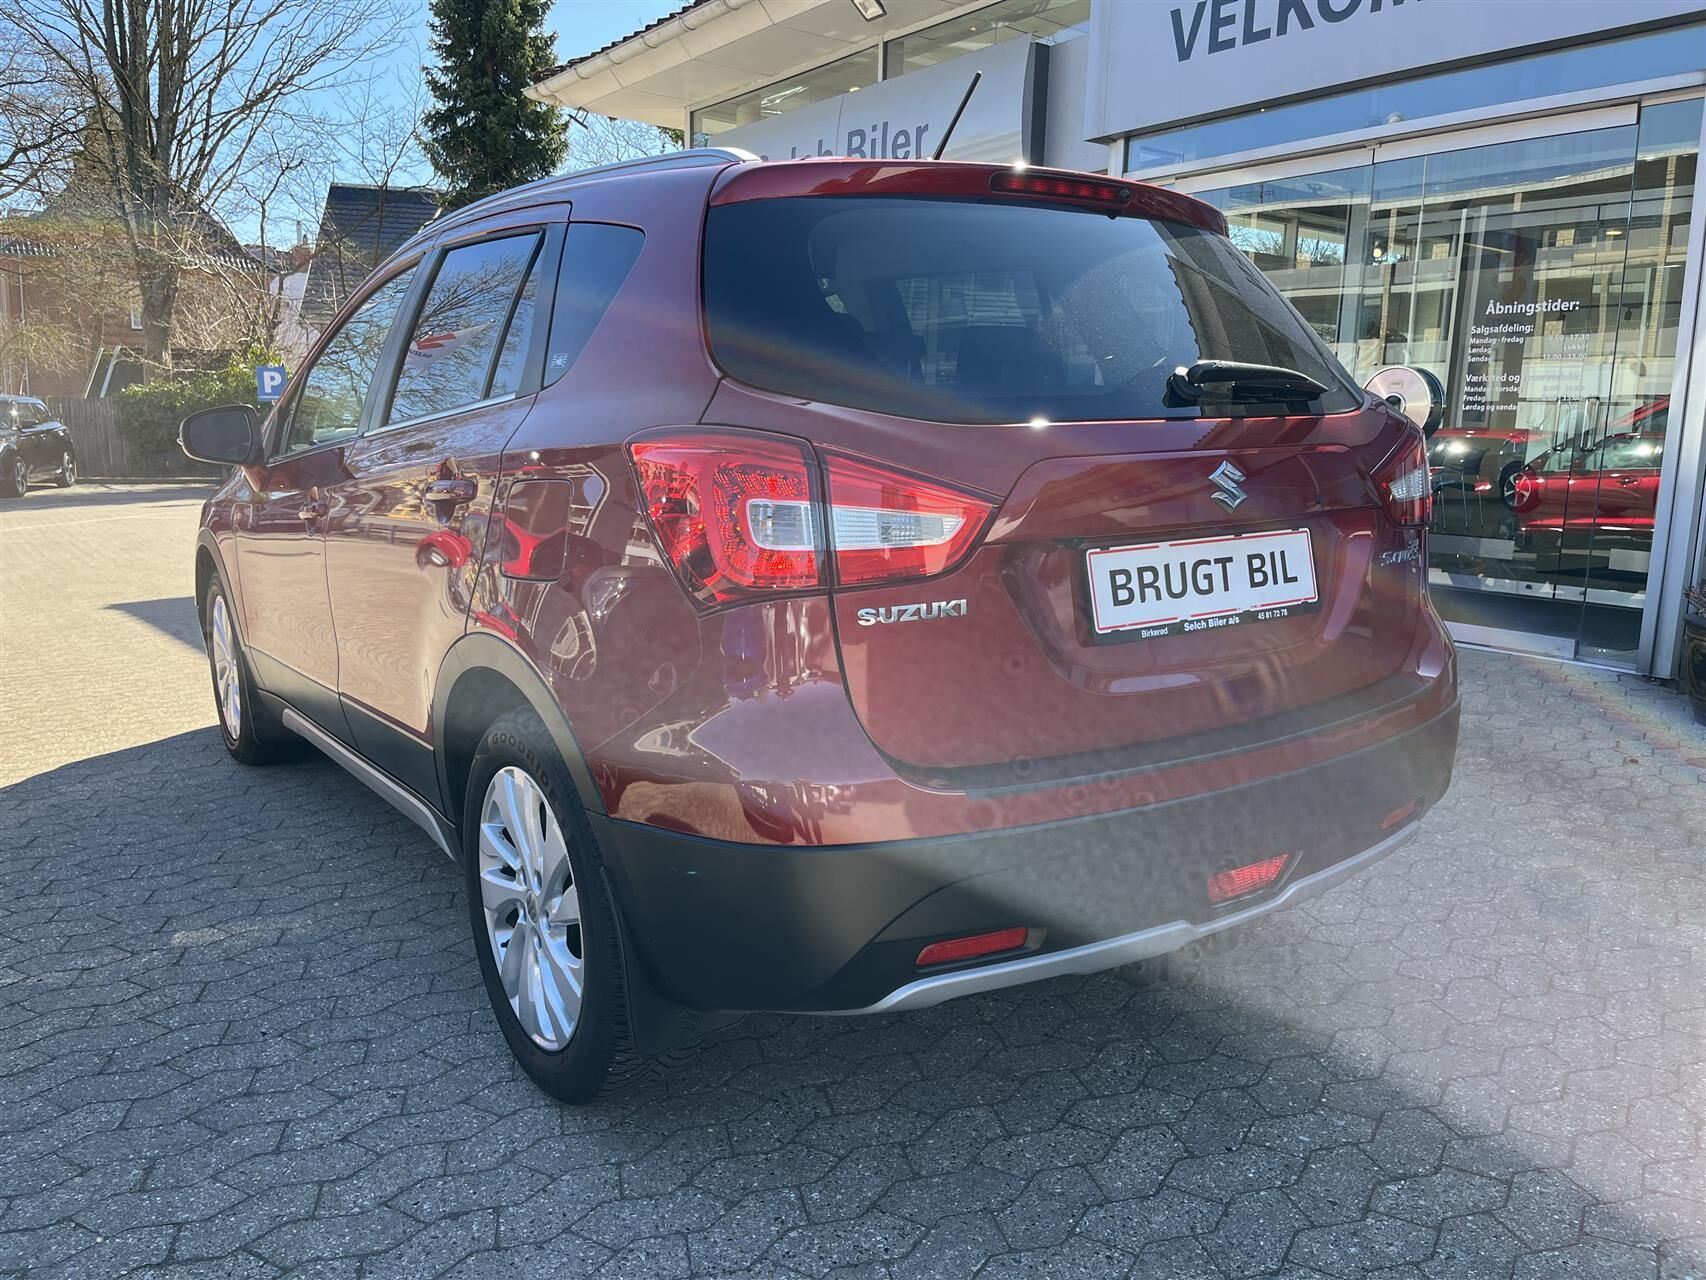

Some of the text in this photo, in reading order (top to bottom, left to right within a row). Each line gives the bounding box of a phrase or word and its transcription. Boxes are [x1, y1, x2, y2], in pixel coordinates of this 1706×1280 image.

[1170, 0, 1425, 62] VELK
[847, 121, 928, 160] Biler
[1485, 299, 1580, 316] Åbningstider:
[1471, 324, 1535, 335] Salgsafdeling:
[1501, 336, 1524, 344] fredag
[263, 371, 282, 393] P
[1508, 375, 1520, 384] og
[1109, 550, 1298, 607] BRUGT BIL
[857, 599, 968, 626] SUZUKI
[1141, 627, 1169, 638] Birkerød
[1183, 619, 1207, 632] Selch
[1208, 617, 1227, 629] Biler
